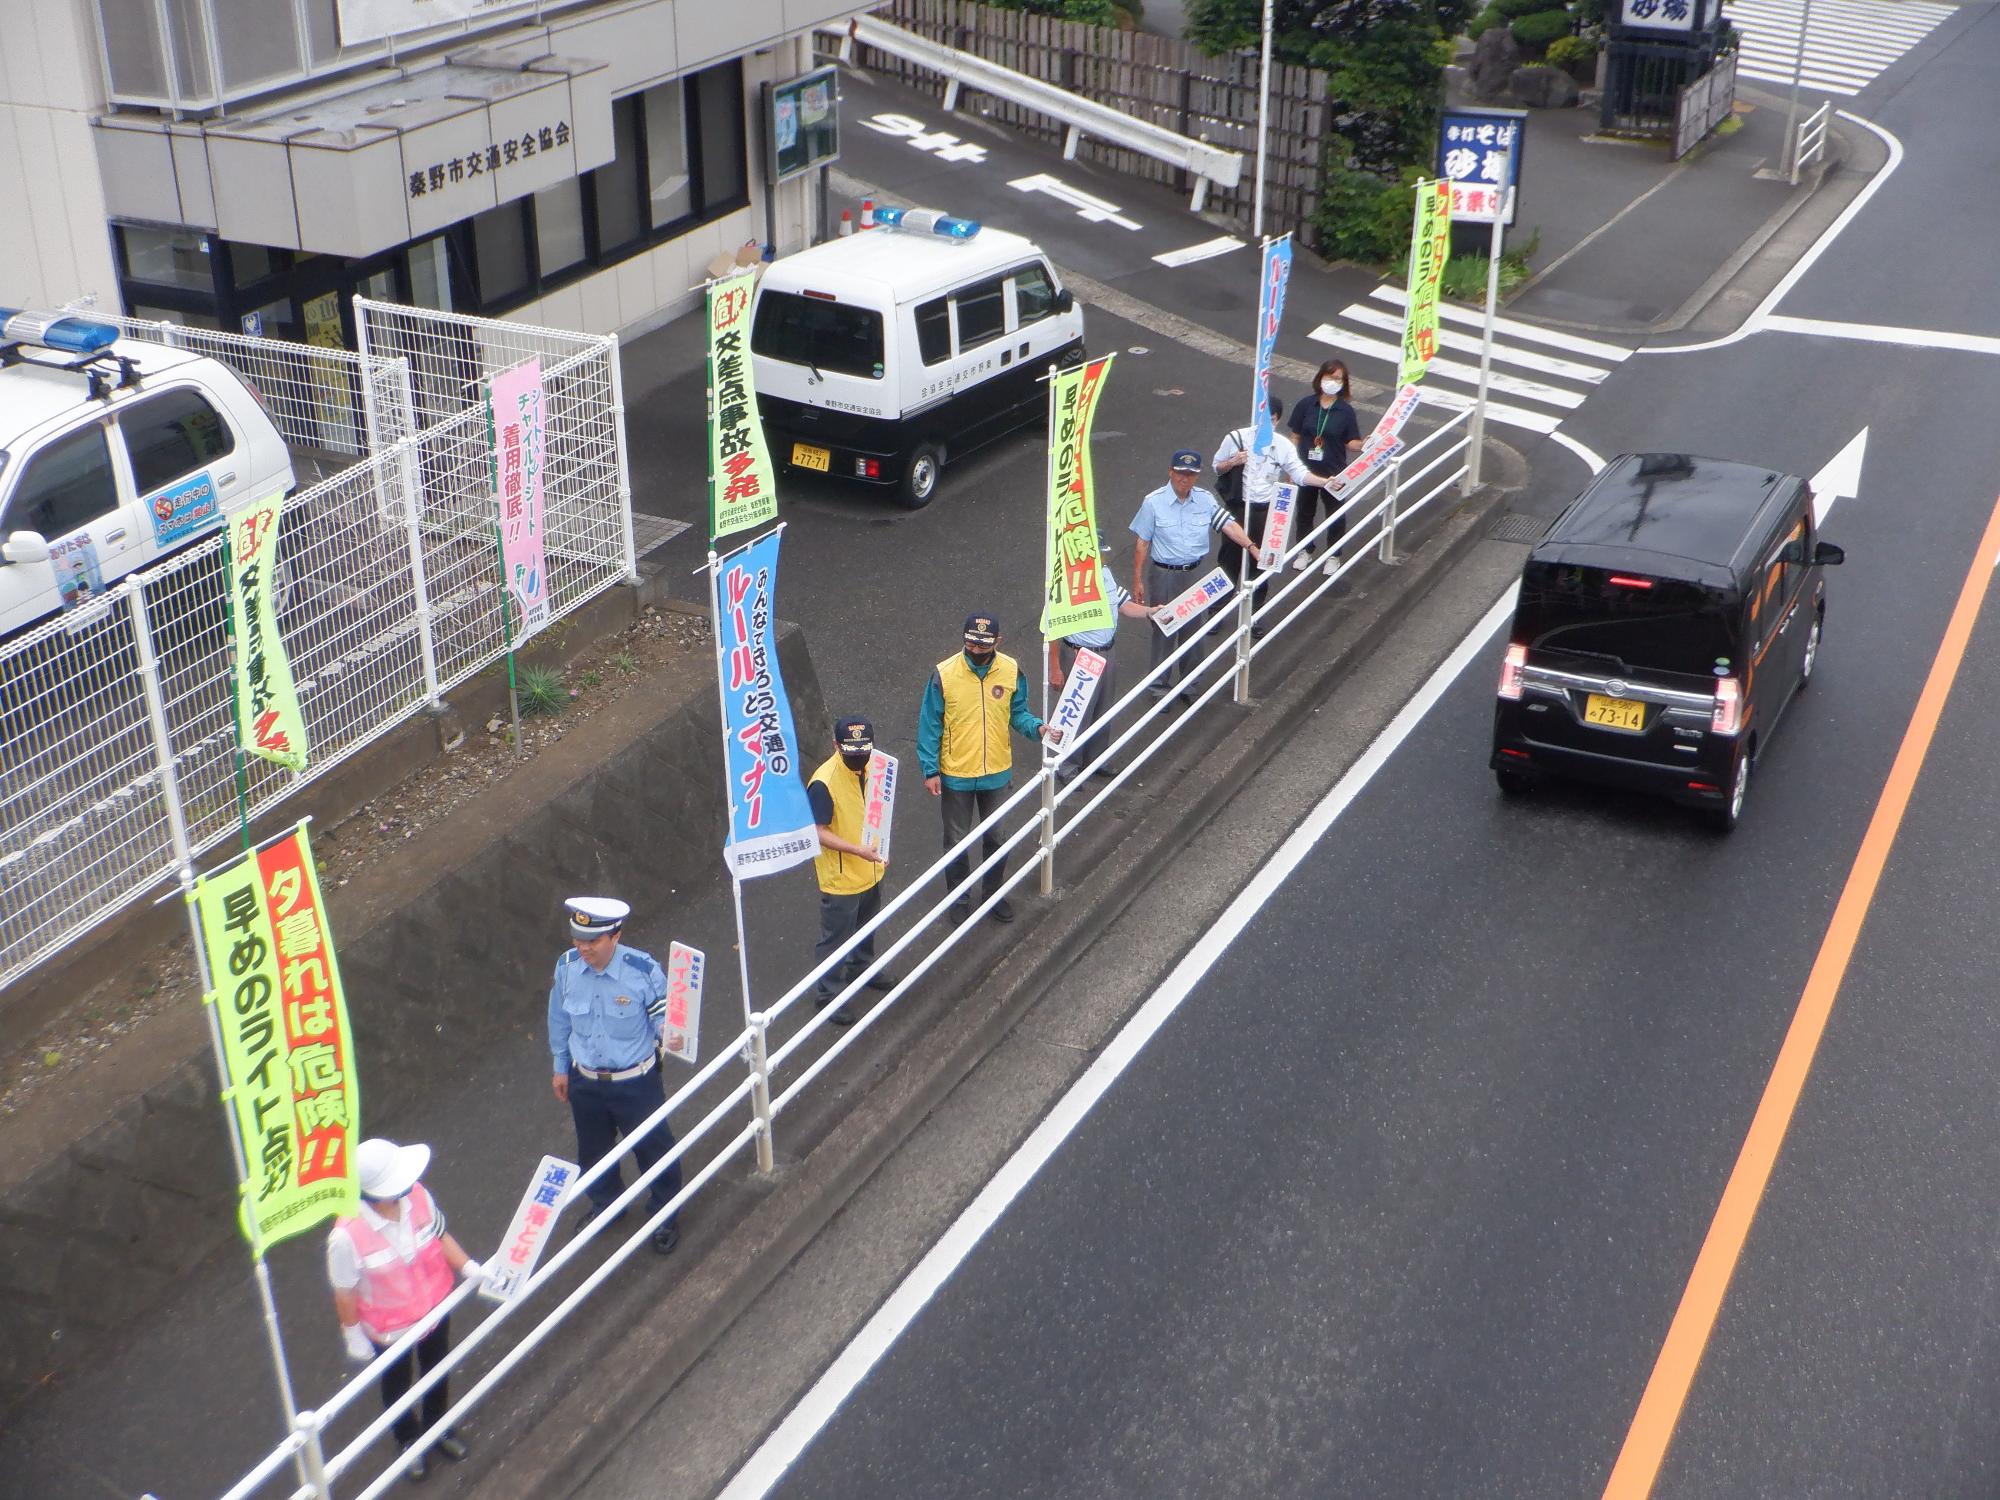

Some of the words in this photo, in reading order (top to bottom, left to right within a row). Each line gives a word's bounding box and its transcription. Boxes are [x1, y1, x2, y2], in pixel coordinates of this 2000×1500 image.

[409, 120, 569, 198] 秦野市交通安全協会
[715, 329, 760, 504] 交差点事故多発
[800, 453, 826, 470] 77-71
[1060, 669, 1093, 728] シートベルト
[1598, 707, 1639, 728] 73-14
[221, 881, 293, 1202] 早めのライト点灯
[268, 865, 351, 1173] 夕暮れは危険!!
